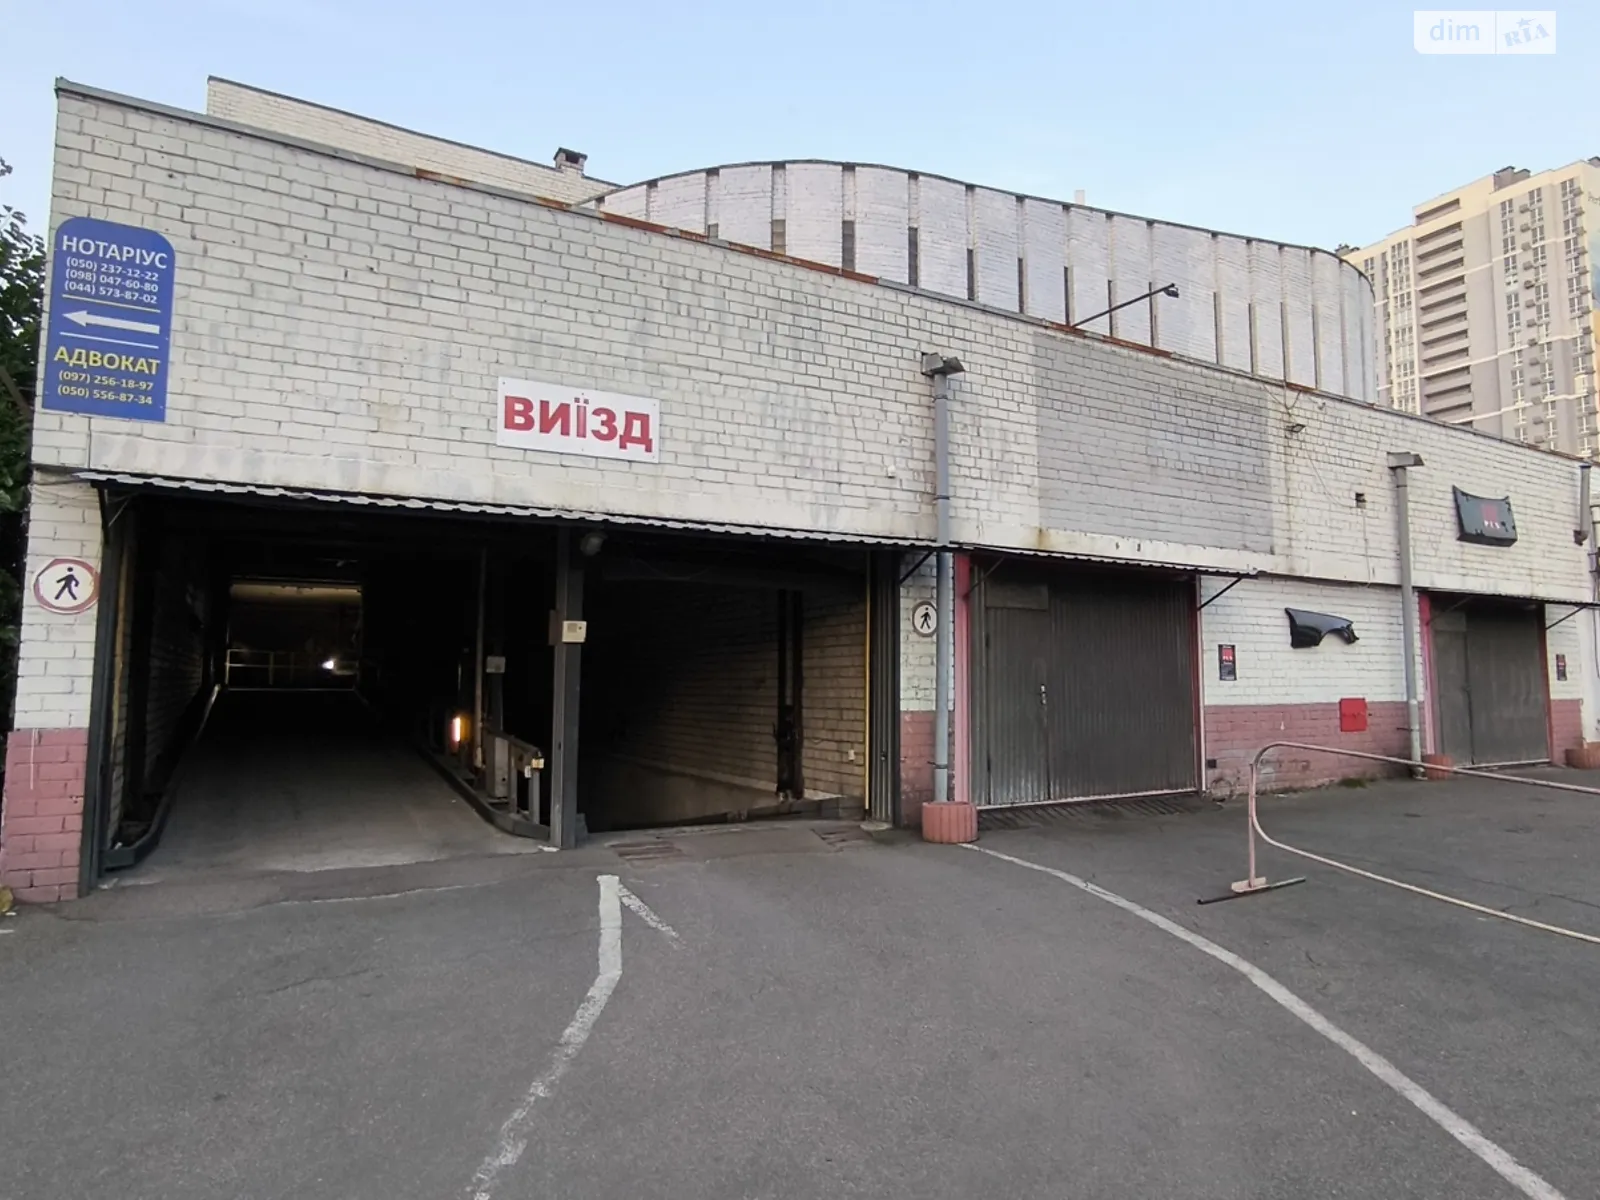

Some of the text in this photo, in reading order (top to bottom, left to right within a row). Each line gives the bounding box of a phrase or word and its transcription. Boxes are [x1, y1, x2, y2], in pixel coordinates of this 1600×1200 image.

[61, 234, 169, 269] НОТАРІУС
[65, 268, 159, 293] (098) 047-60-80
[66, 256, 159, 281] (050) 237-12-22
[64, 280, 158, 304] (044) 573-87-02
[53, 345, 162, 375] АДВОКАТ
[58, 370, 154, 391] (097) 256-18-97
[57, 384, 153, 405] (050) 556-87-34
[504, 395, 653, 453] ВИЇЗД
